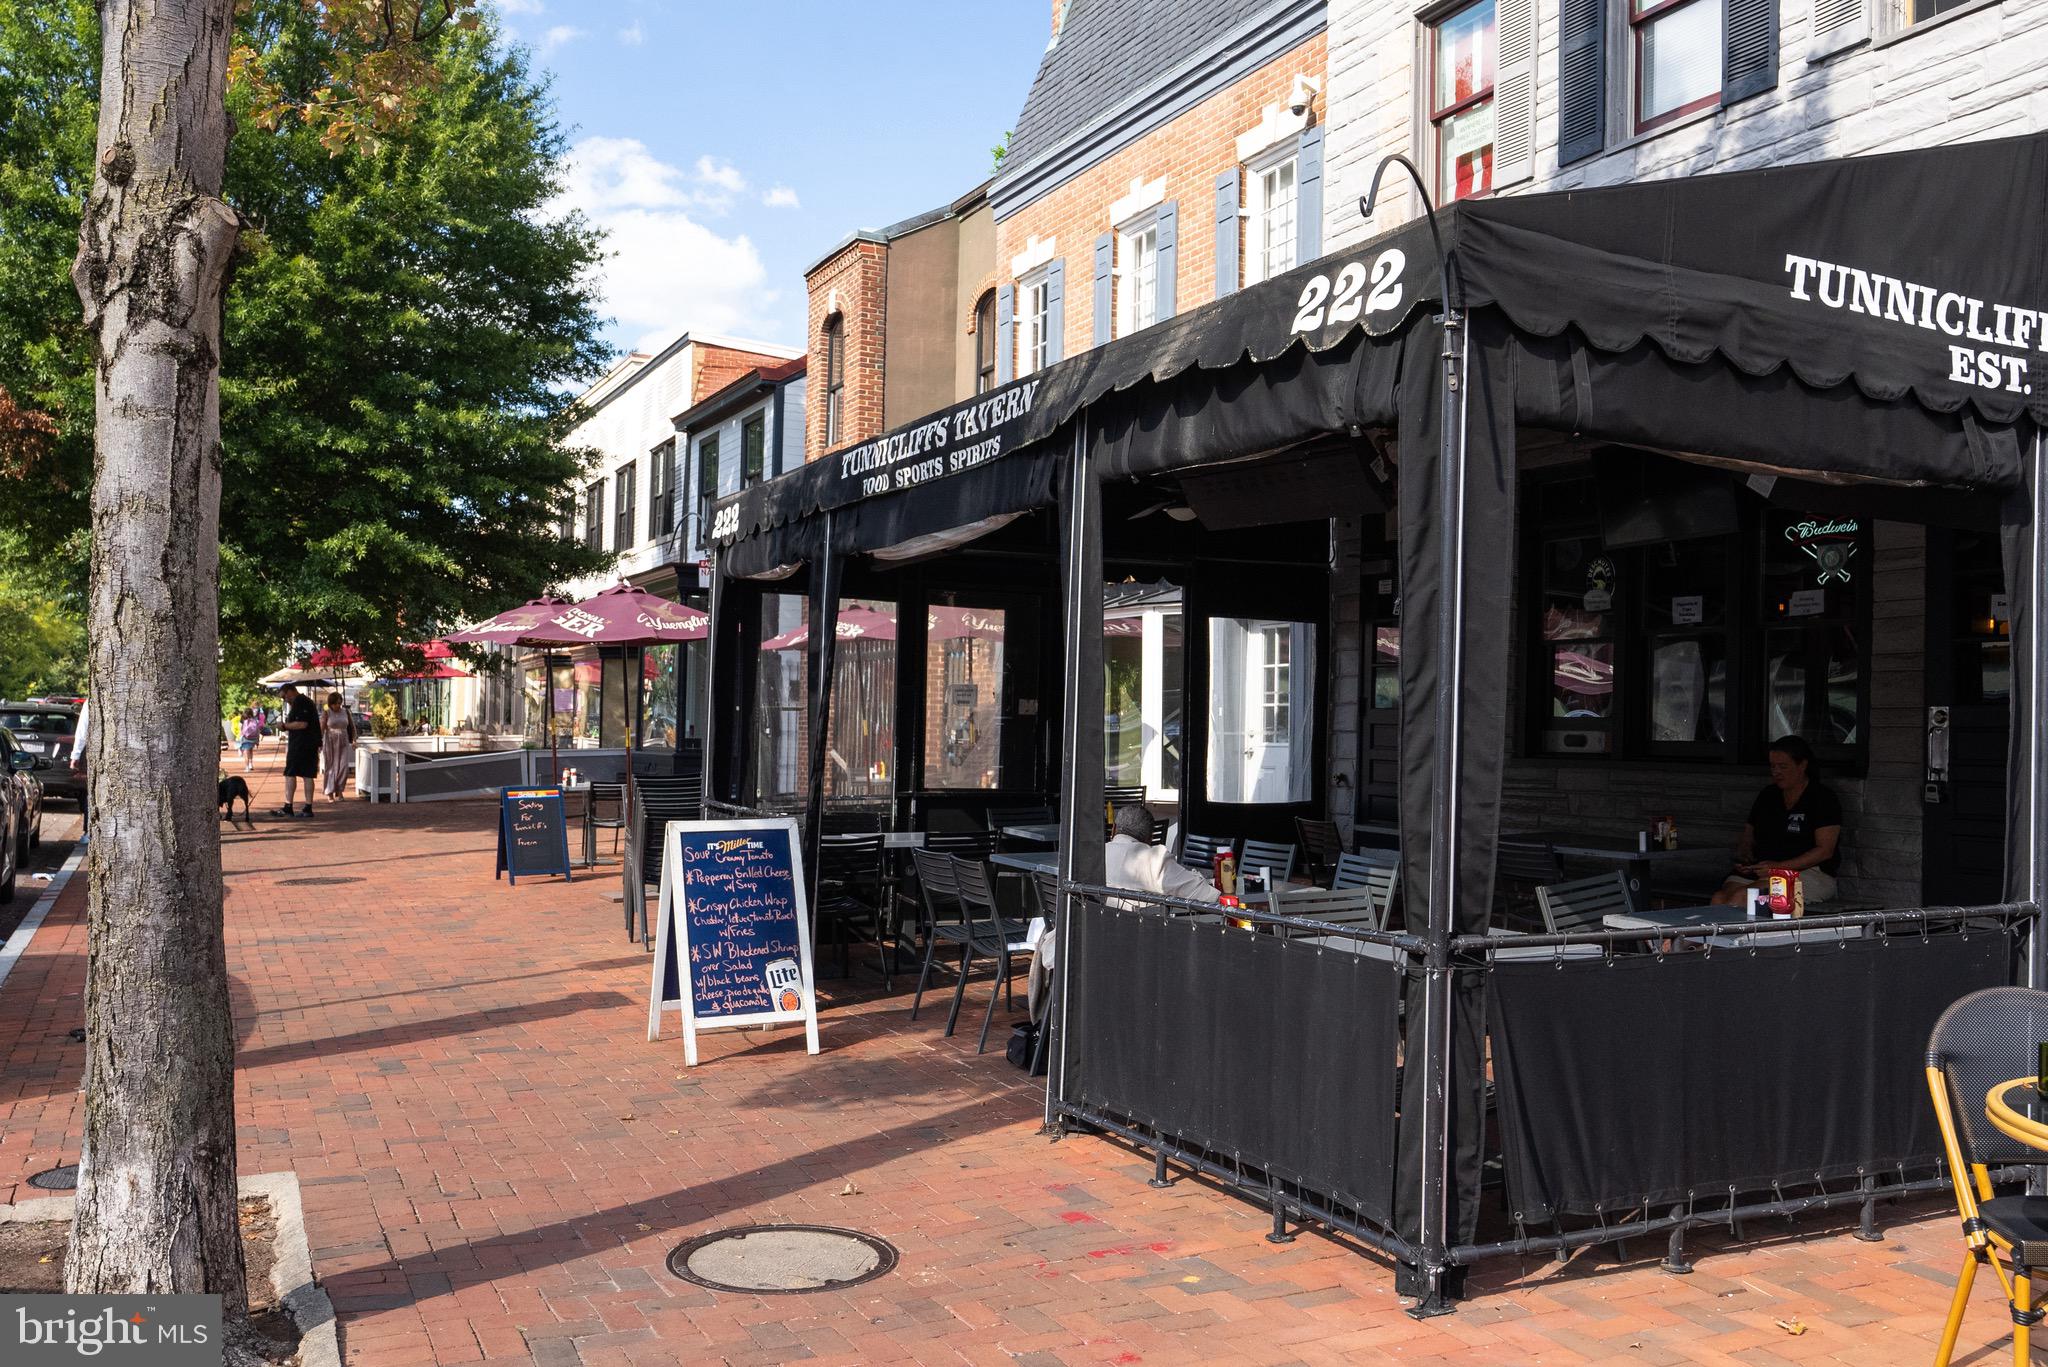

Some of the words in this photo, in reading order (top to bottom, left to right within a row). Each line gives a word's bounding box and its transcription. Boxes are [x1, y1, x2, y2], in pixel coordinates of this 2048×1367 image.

[1290, 248, 1406, 336] 222
[1948, 344, 2032, 396] EST.
[841, 415, 951, 480] TUNNICLIFFS
[953, 379, 1040, 442] TAVERN
[862, 472, 890, 497] FOOD
[895, 456, 944, 488] SPORTS
[949, 434, 1002, 472] SPIRITS
[712, 502, 740, 540] 222
[520, 813, 534, 821] For
[718, 838, 752, 854] Miller
[747, 841, 764, 849] TIME
[715, 853, 745, 866] Creamy
[740, 849, 774, 861] Tomato
[735, 866, 763, 878] Grilled
[697, 897, 728, 915] Crispy
[729, 895, 764, 909] Chicken
[764, 893, 788, 909] Wrap
[724, 940, 769, 959] Blackened
[770, 939, 799, 957] Shrimp
[701, 962, 720, 973] over
[721, 959, 753, 972] Salad
[769, 967, 797, 989] Lite
